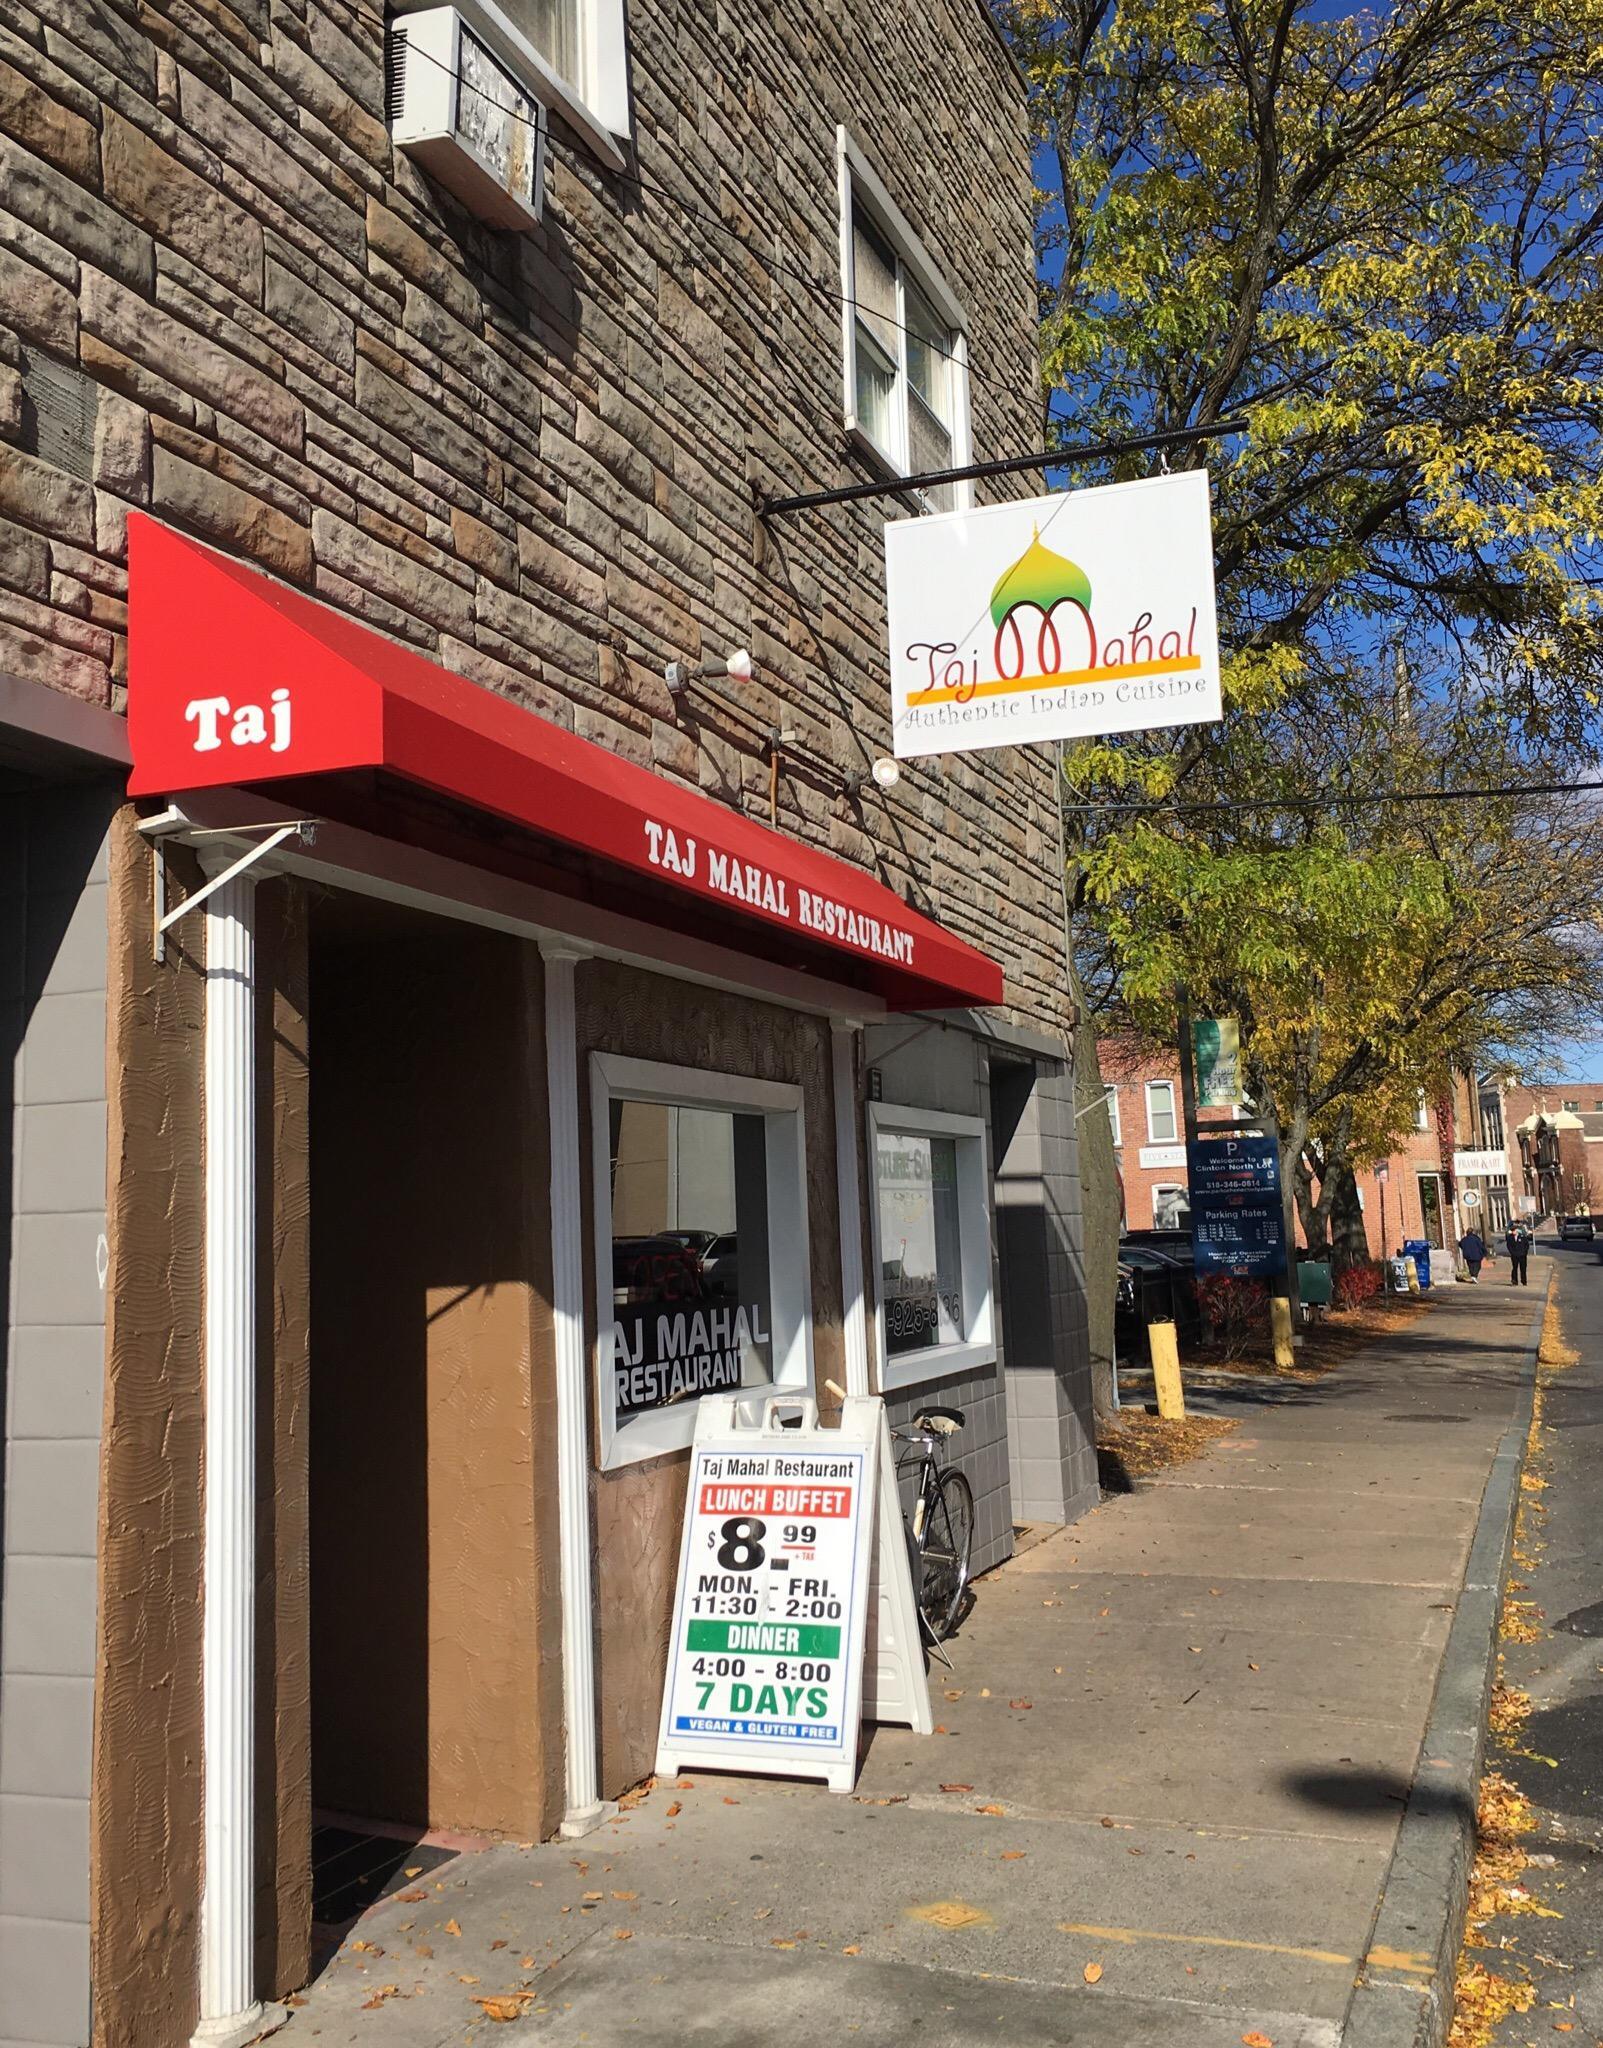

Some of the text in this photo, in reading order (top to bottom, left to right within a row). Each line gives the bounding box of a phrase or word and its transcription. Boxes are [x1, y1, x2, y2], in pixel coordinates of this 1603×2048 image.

[906, 596, 1197, 704] Taj Mahal
[904, 677, 1207, 730] Authentic Indian Cuisine
[185, 688, 291, 752] Taj
[644, 820, 914, 965] TAJ MAHAL RESTAURANT
[1203, 1076, 1236, 1090] FREE
[1195, 1164, 1226, 1172] Clinton
[1229, 1163, 1254, 1171] North
[1205, 1209, 1268, 1220] Parking Rates
[657, 1304, 769, 1361] MAHAL
[616, 1350, 747, 1408] RESTAURANT
[703, 1459, 854, 1480] Taj Mahal Restaurant
[705, 1488, 846, 1514] LUNCH BUFFET
[698, 1575, 759, 1595] MON.
[788, 1578, 836, 1598] FRI.
[691, 1595, 757, 1615] 11:30
[785, 1599, 842, 1620] 2:00
[727, 1625, 800, 1652] DINNER
[691, 1657, 746, 1678] 4:00
[775, 1662, 831, 1682] 8:00
[695, 1681, 829, 1719] 7 DAYS
[689, 1718, 834, 1739] VEGAN & GLUTEN FREE
